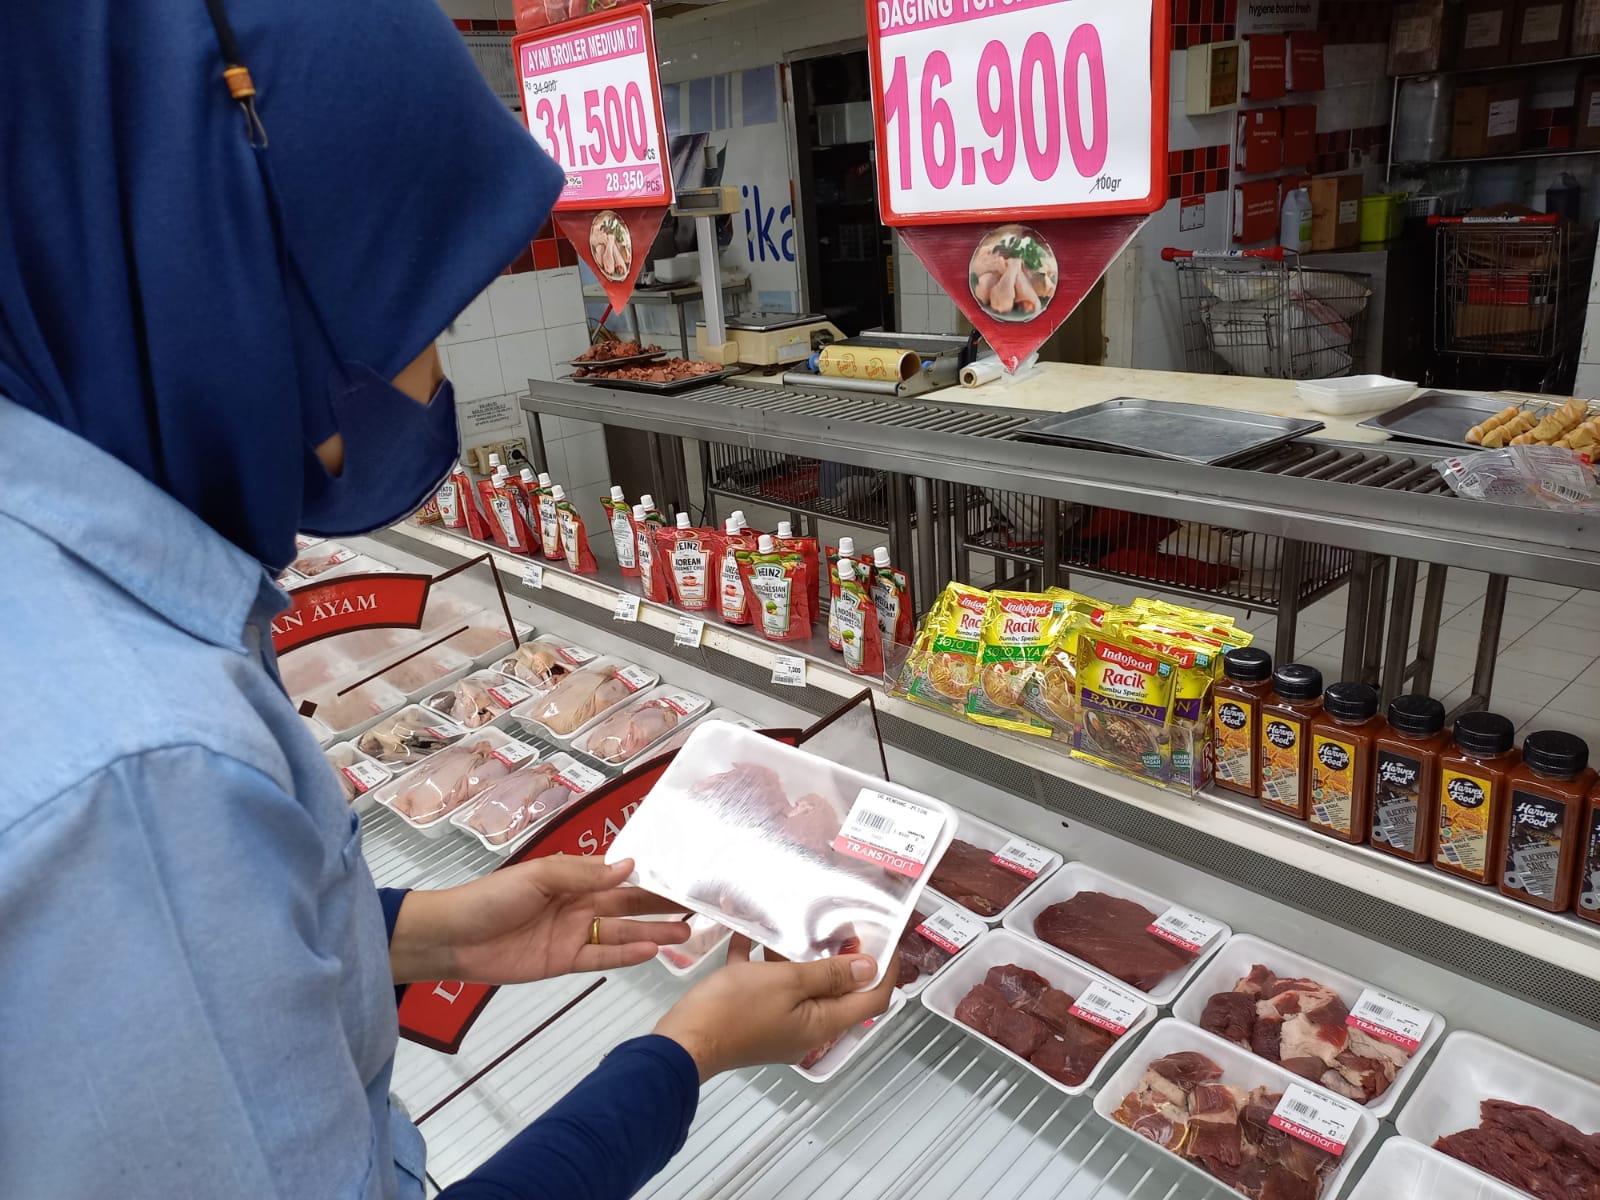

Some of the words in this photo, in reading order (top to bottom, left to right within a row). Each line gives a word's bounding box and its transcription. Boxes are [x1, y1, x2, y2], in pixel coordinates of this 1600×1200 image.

[879, 0, 953, 30] DAGING
[528, 47, 550, 72] AYAM
[551, 38, 588, 66] BROILER
[588, 30, 626, 57] MEDIUM
[626, 25, 638, 49] 07
[884, 23, 1108, 190] 16.900
[536, 81, 648, 167] 31.500
[606, 170, 643, 192] 28.350
[646, 179, 661, 192] PCS
[271, 611, 304, 638] AN
[311, 593, 378, 622] AYAM
[1006, 602, 1047, 614] Indofood
[961, 613, 982, 629] Rac
[1004, 619, 1039, 633] Racik
[1101, 648, 1153, 672] Indofood
[1102, 668, 1145, 690] Racik
[1090, 694, 1157, 718] RAWON
[1219, 705, 1247, 721] Harvey
[1221, 715, 1241, 726] Food
[1267, 723, 1296, 741] Harvey
[1268, 733, 1290, 745] Food
[1318, 744, 1350, 763] Harvey
[1320, 755, 1343, 767] Food
[1380, 761, 1415, 780] Harvey
[1382, 771, 1408, 785] Food
[1448, 781, 1484, 800] Harvey
[1450, 791, 1476, 805] Food
[1516, 802, 1558, 823] Harvey
[1519, 813, 1548, 828] Food
[846, 841, 915, 871] TRANSmart
[1280, 1120, 1337, 1150] TRANSmart
